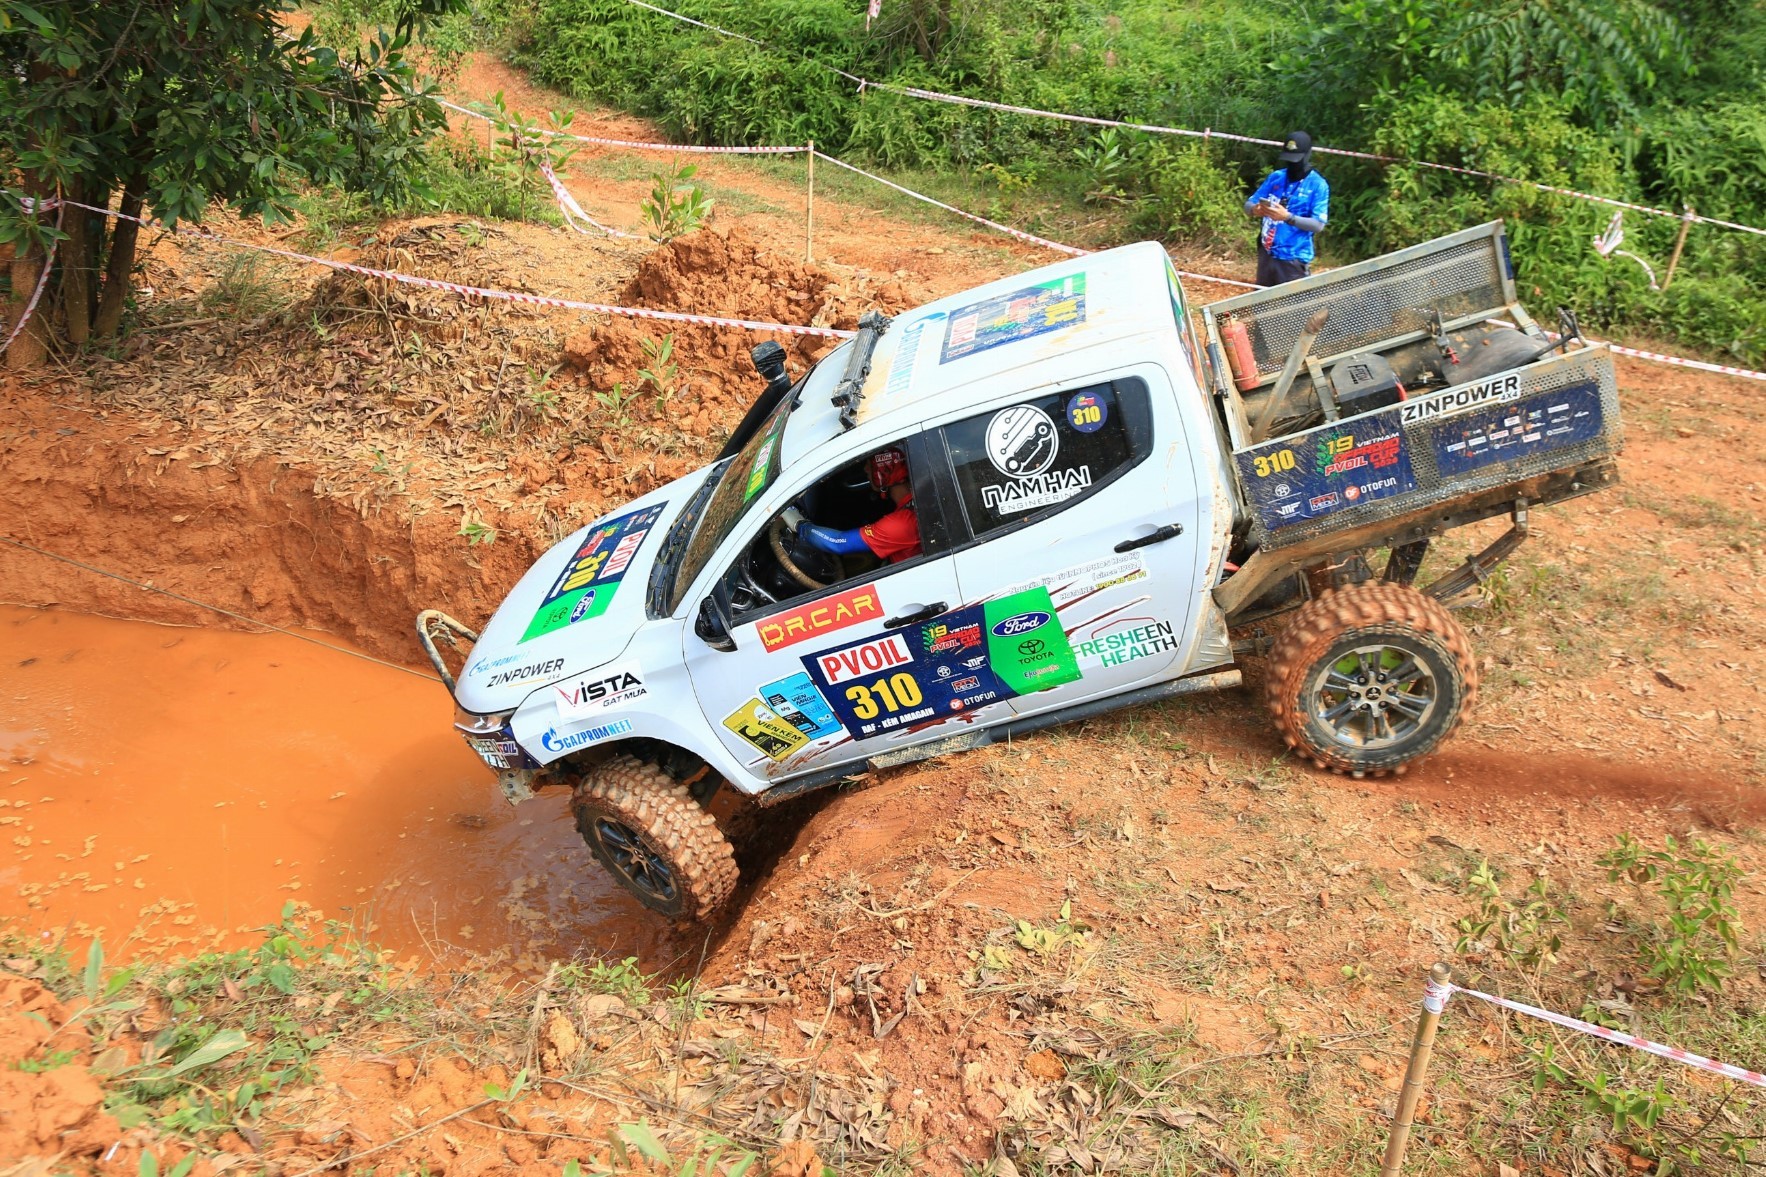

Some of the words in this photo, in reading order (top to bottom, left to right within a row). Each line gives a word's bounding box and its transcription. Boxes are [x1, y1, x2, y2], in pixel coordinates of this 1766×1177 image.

[1402, 375, 1518, 422] ZINPOWER
[1072, 405, 1101, 426] 310
[1327, 435, 1354, 455] 19
[1356, 431, 1400, 448] VIETNAM
[1253, 449, 1296, 478] 310
[1324, 455, 1368, 477] PVOIL
[1369, 446, 1400, 463] CUP
[982, 467, 1091, 507] NAMHAI
[1360, 477, 1397, 494] OTOFUN
[602, 532, 644, 576] PVOIL
[562, 551, 609, 592] 310
[572, 595, 595, 618] Ford
[760, 594, 876, 647] DR.CAR
[929, 624, 948, 639] 19
[949, 622, 979, 634] VIETNAM
[1003, 614, 1040, 635] Ford
[1070, 620, 1173, 657] FRESHEEN
[929, 639, 961, 654] PVOIL
[960, 632, 981, 645] CUP
[1101, 635, 1178, 668] HEALTH
[822, 639, 909, 682] PVOIL
[1018, 651, 1055, 666] TOYOTA
[486, 658, 565, 689] ZINPOWER
[845, 672, 923, 720] 310
[963, 690, 996, 705] OTOFUN
[899, 707, 935, 724] AMAGAIN
[563, 720, 634, 749] GAZPROMNEFT
